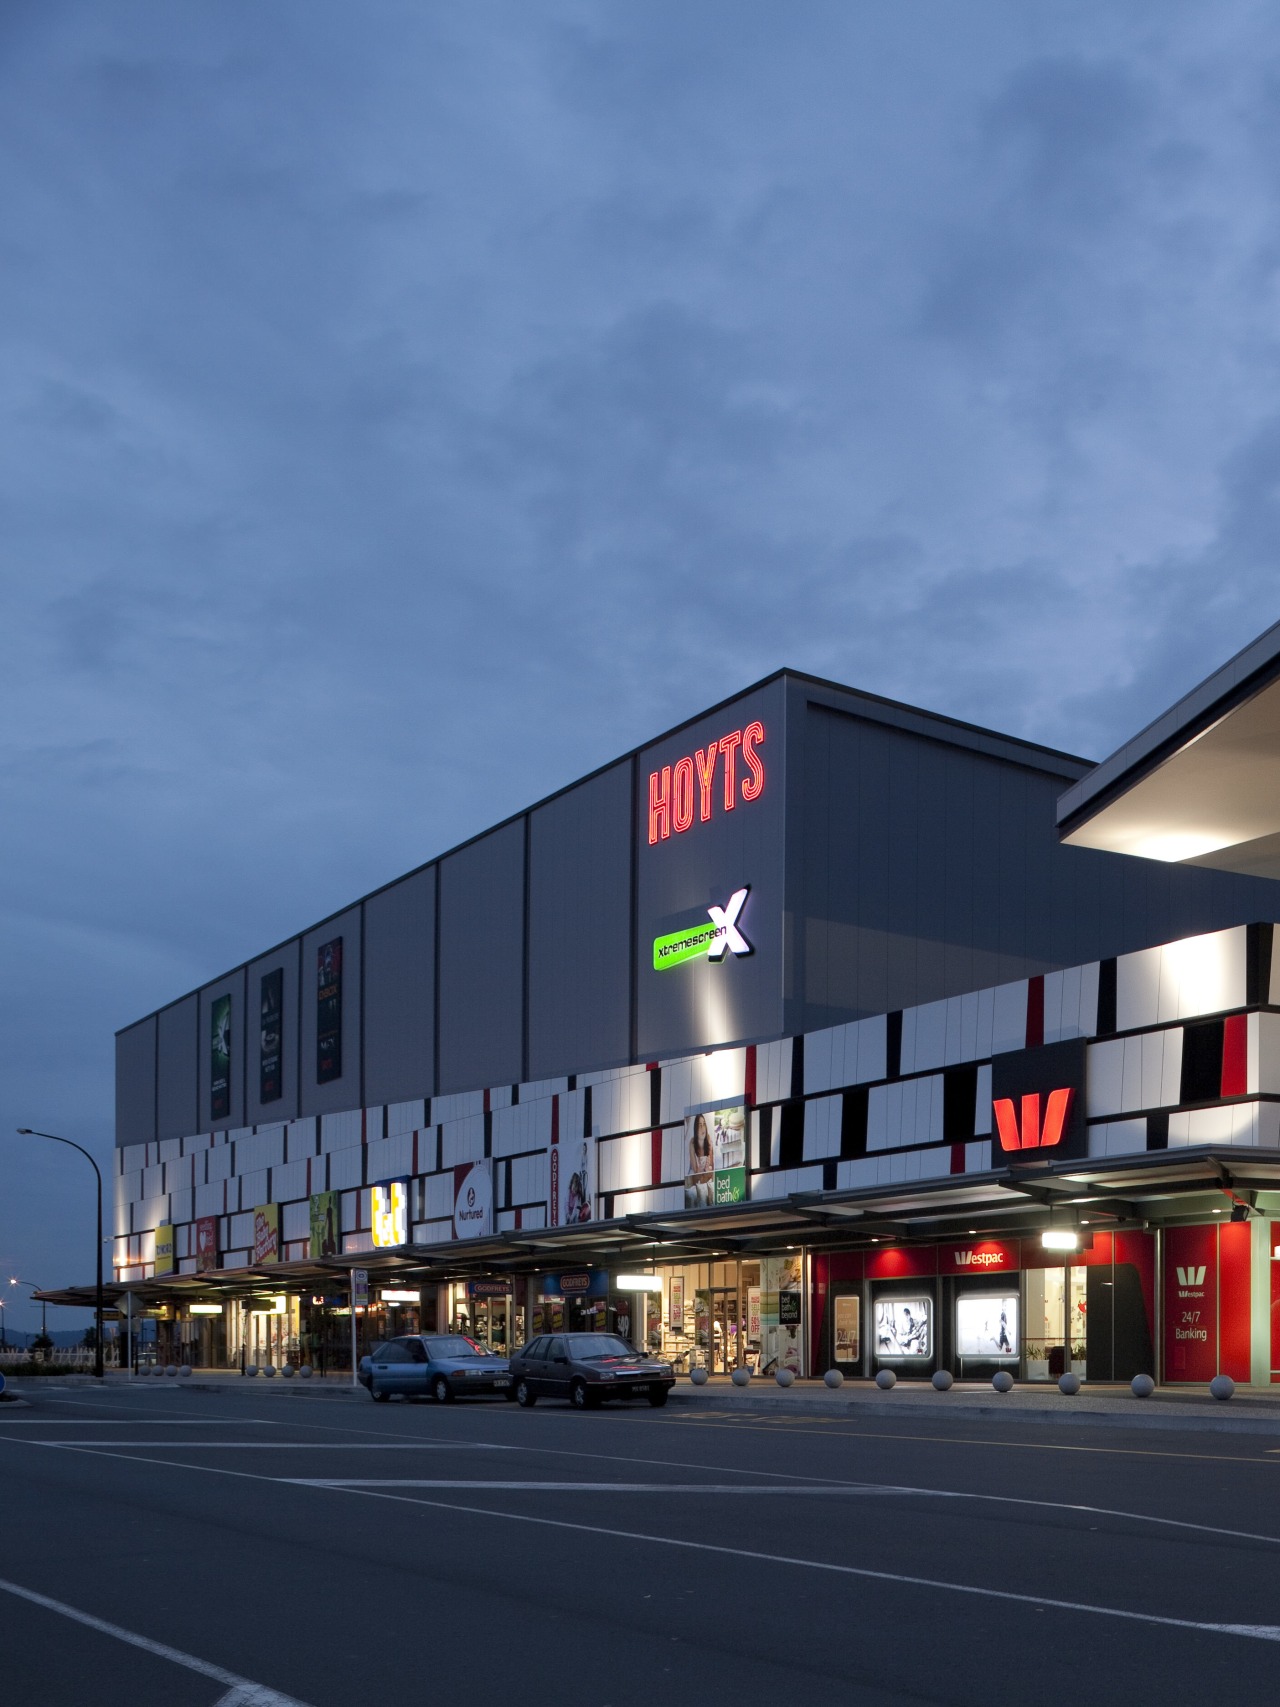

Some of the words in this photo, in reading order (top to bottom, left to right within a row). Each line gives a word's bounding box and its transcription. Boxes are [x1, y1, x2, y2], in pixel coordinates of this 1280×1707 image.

[648, 721, 765, 845] HOYTS
[658, 926, 727, 958] xtremescreen
[716, 1175, 730, 1190] bed
[459, 1208, 484, 1221] Nurtured
[954, 1251, 1003, 1266] Westpac
[477, 1284, 510, 1292] GODFREYS
[562, 1277, 588, 1288] GODFREYS
[781, 1295, 790, 1303] bed
[1178, 1290, 1205, 1298] Westpac
[781, 1311, 798, 1321] beyond
[1182, 1311, 1201, 1324] 24/7
[1175, 1328, 1207, 1342] Banking
